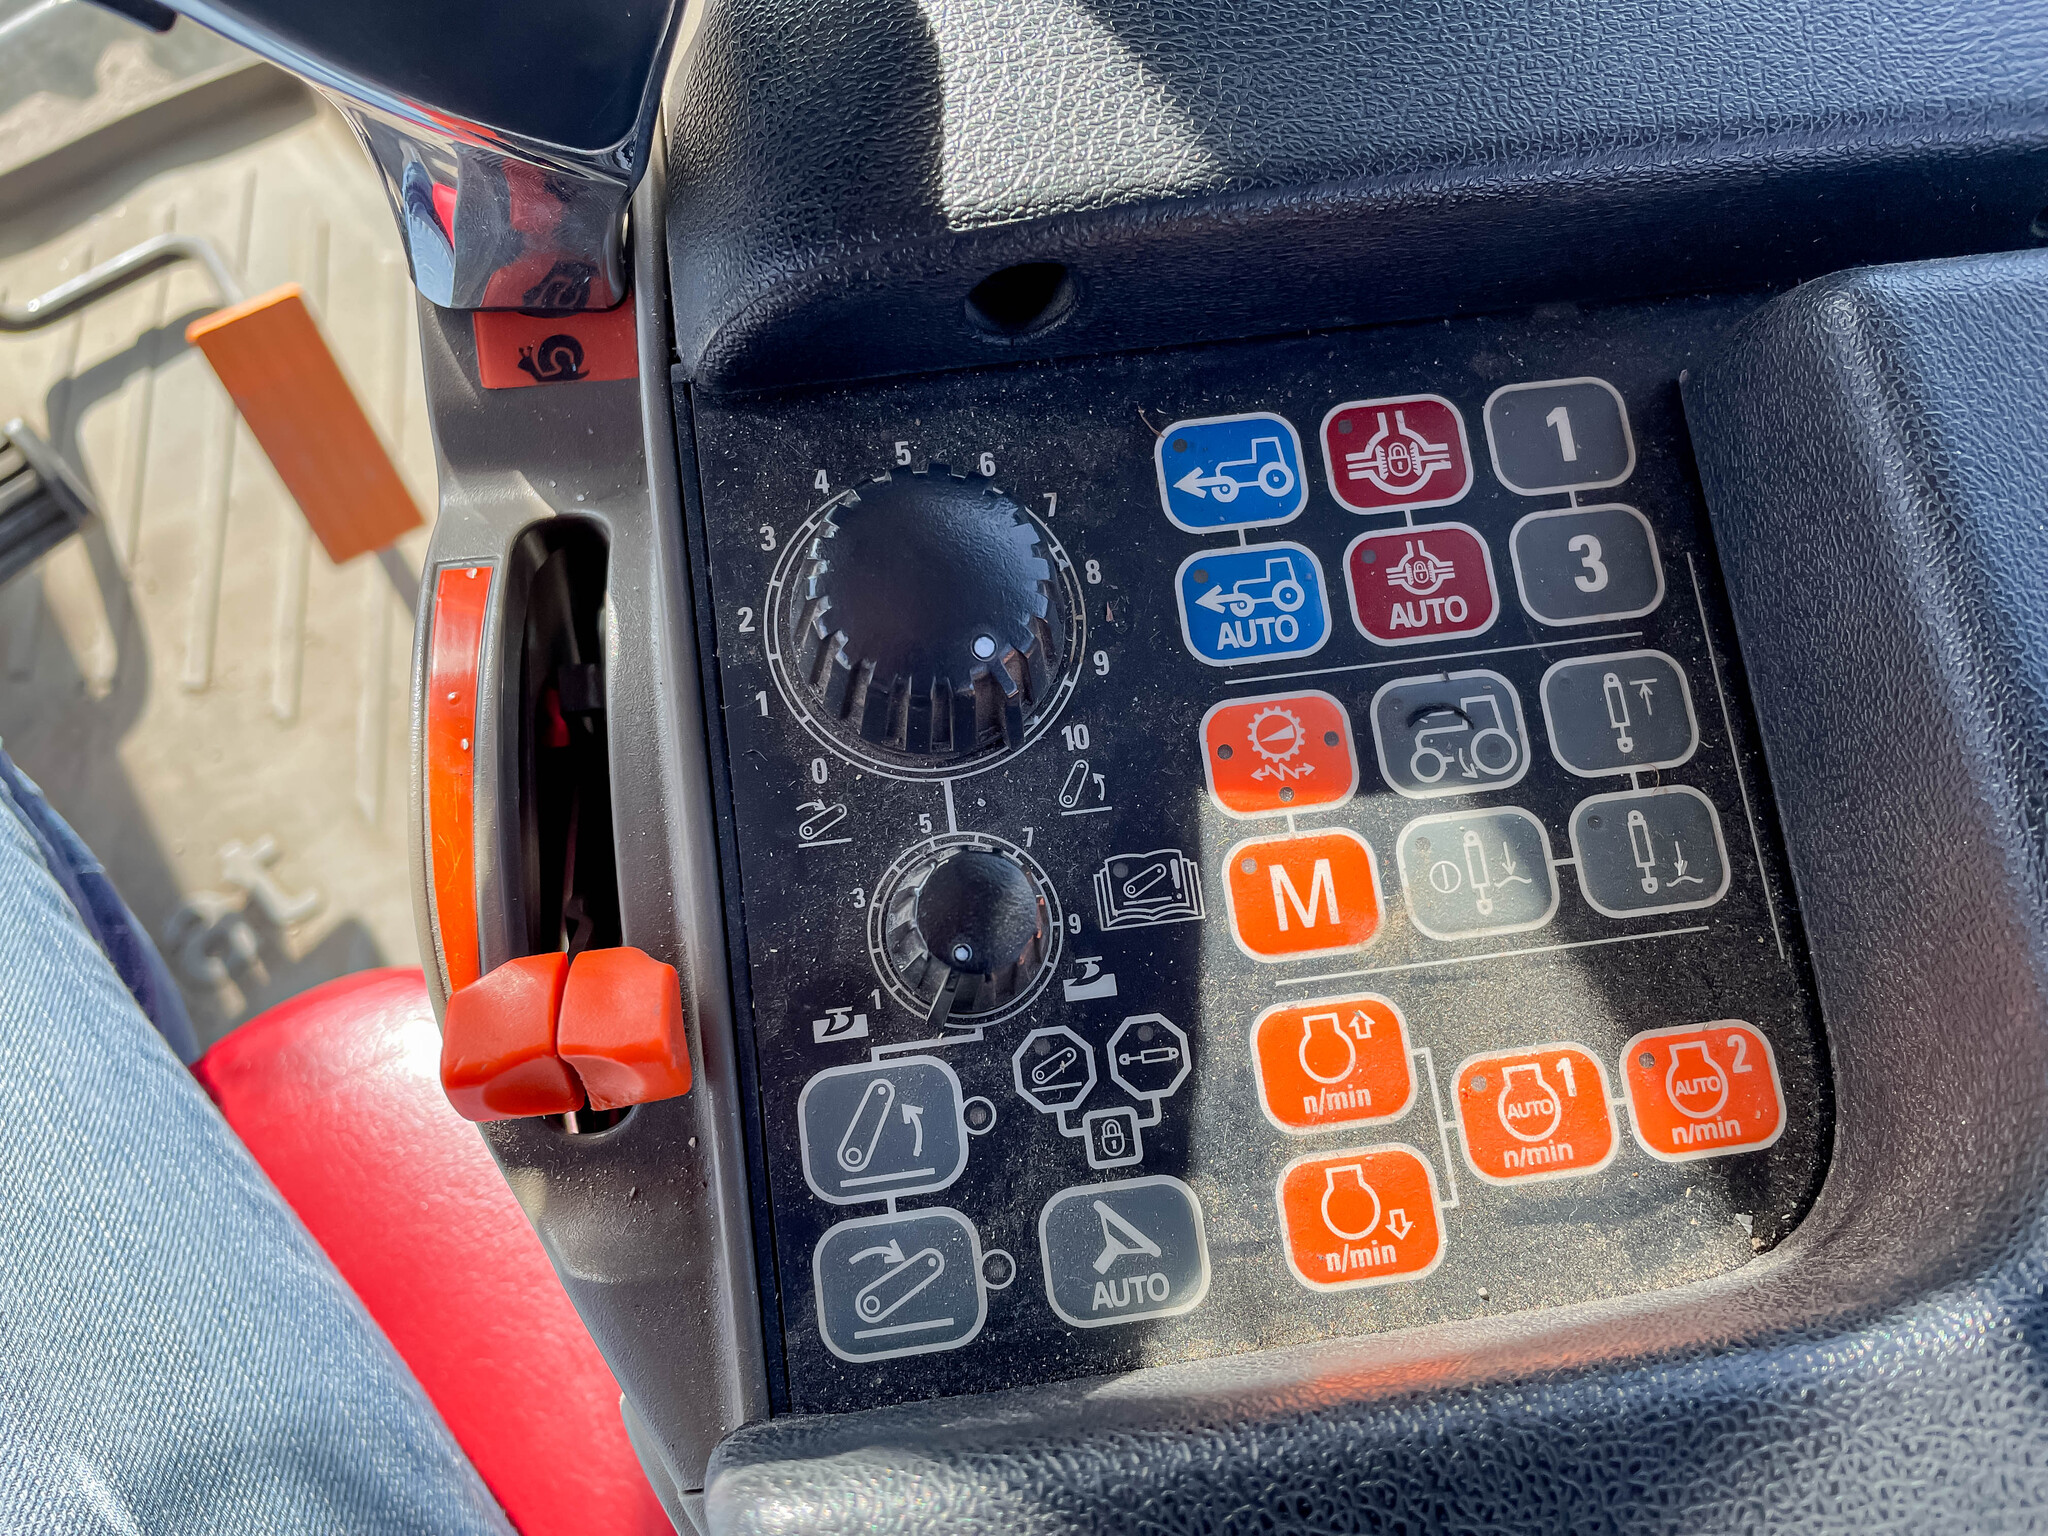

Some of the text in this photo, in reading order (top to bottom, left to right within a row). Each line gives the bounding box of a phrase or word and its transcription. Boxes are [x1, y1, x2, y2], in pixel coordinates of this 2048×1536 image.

[1545, 406, 1578, 462] 1
[895, 441, 911, 466] 5
[980, 452, 996, 477] 6
[814, 470, 830, 494] 4
[1043, 493, 1058, 517] 7
[760, 526, 776, 551] 3
[1085, 559, 1101, 584] 8
[1568, 534, 1609, 593] 3
[737, 607, 755, 633] 2
[1389, 595, 1468, 630] AUTO
[1216, 614, 1300, 651] AUTO
[1093, 650, 1109, 676] 9
[755, 691, 769, 717] 1
[1061, 724, 1090, 751] 10
[811, 758, 827, 783] 0
[919, 813, 932, 834] 5
[1022, 827, 1034, 848] 7
[853, 888, 866, 909] 3
[1268, 858, 1341, 932] M
[1068, 914, 1081, 934] 9
[870, 989, 882, 1010] 1
[1726, 1033, 1753, 1074] 2
[1556, 1057, 1578, 1097] 1
[1674, 1076, 1722, 1098] AUTO
[1303, 1085, 1372, 1116] n/min
[1507, 1098, 1555, 1120] AUTO
[1671, 1115, 1742, 1146] n/min
[1503, 1140, 1574, 1170] n/min
[1325, 1239, 1398, 1273] n/min
[1091, 1272, 1171, 1311] AUTO
